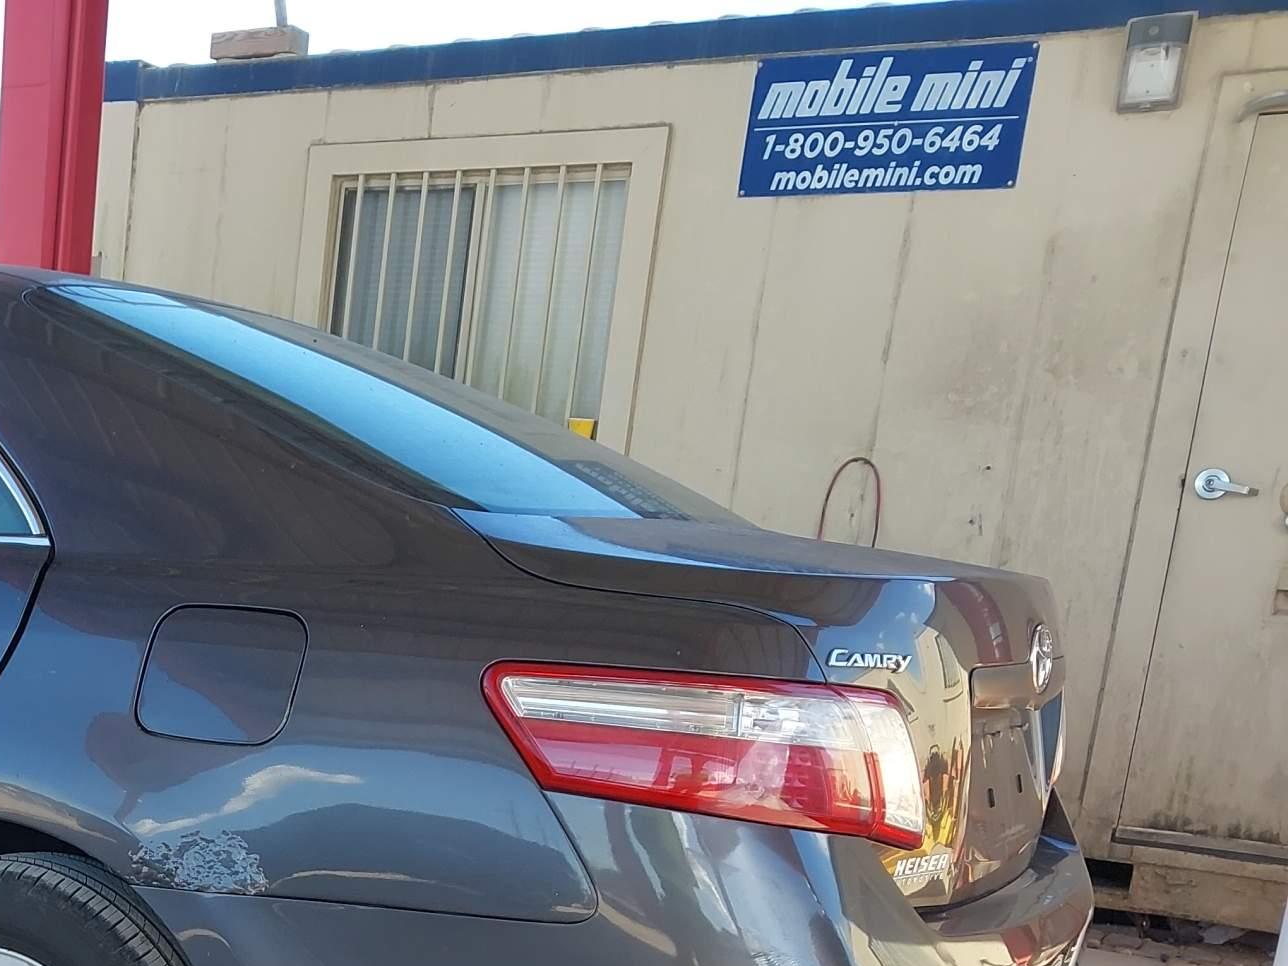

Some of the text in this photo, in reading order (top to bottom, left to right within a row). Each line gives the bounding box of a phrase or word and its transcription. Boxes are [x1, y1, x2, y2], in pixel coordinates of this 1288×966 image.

[757, 56, 1027, 120] mobile mini
[762, 124, 1001, 160] 1-800-950-6464
[769, 161, 983, 191] mobilemini.com
[828, 649, 912, 672] CAMRY
